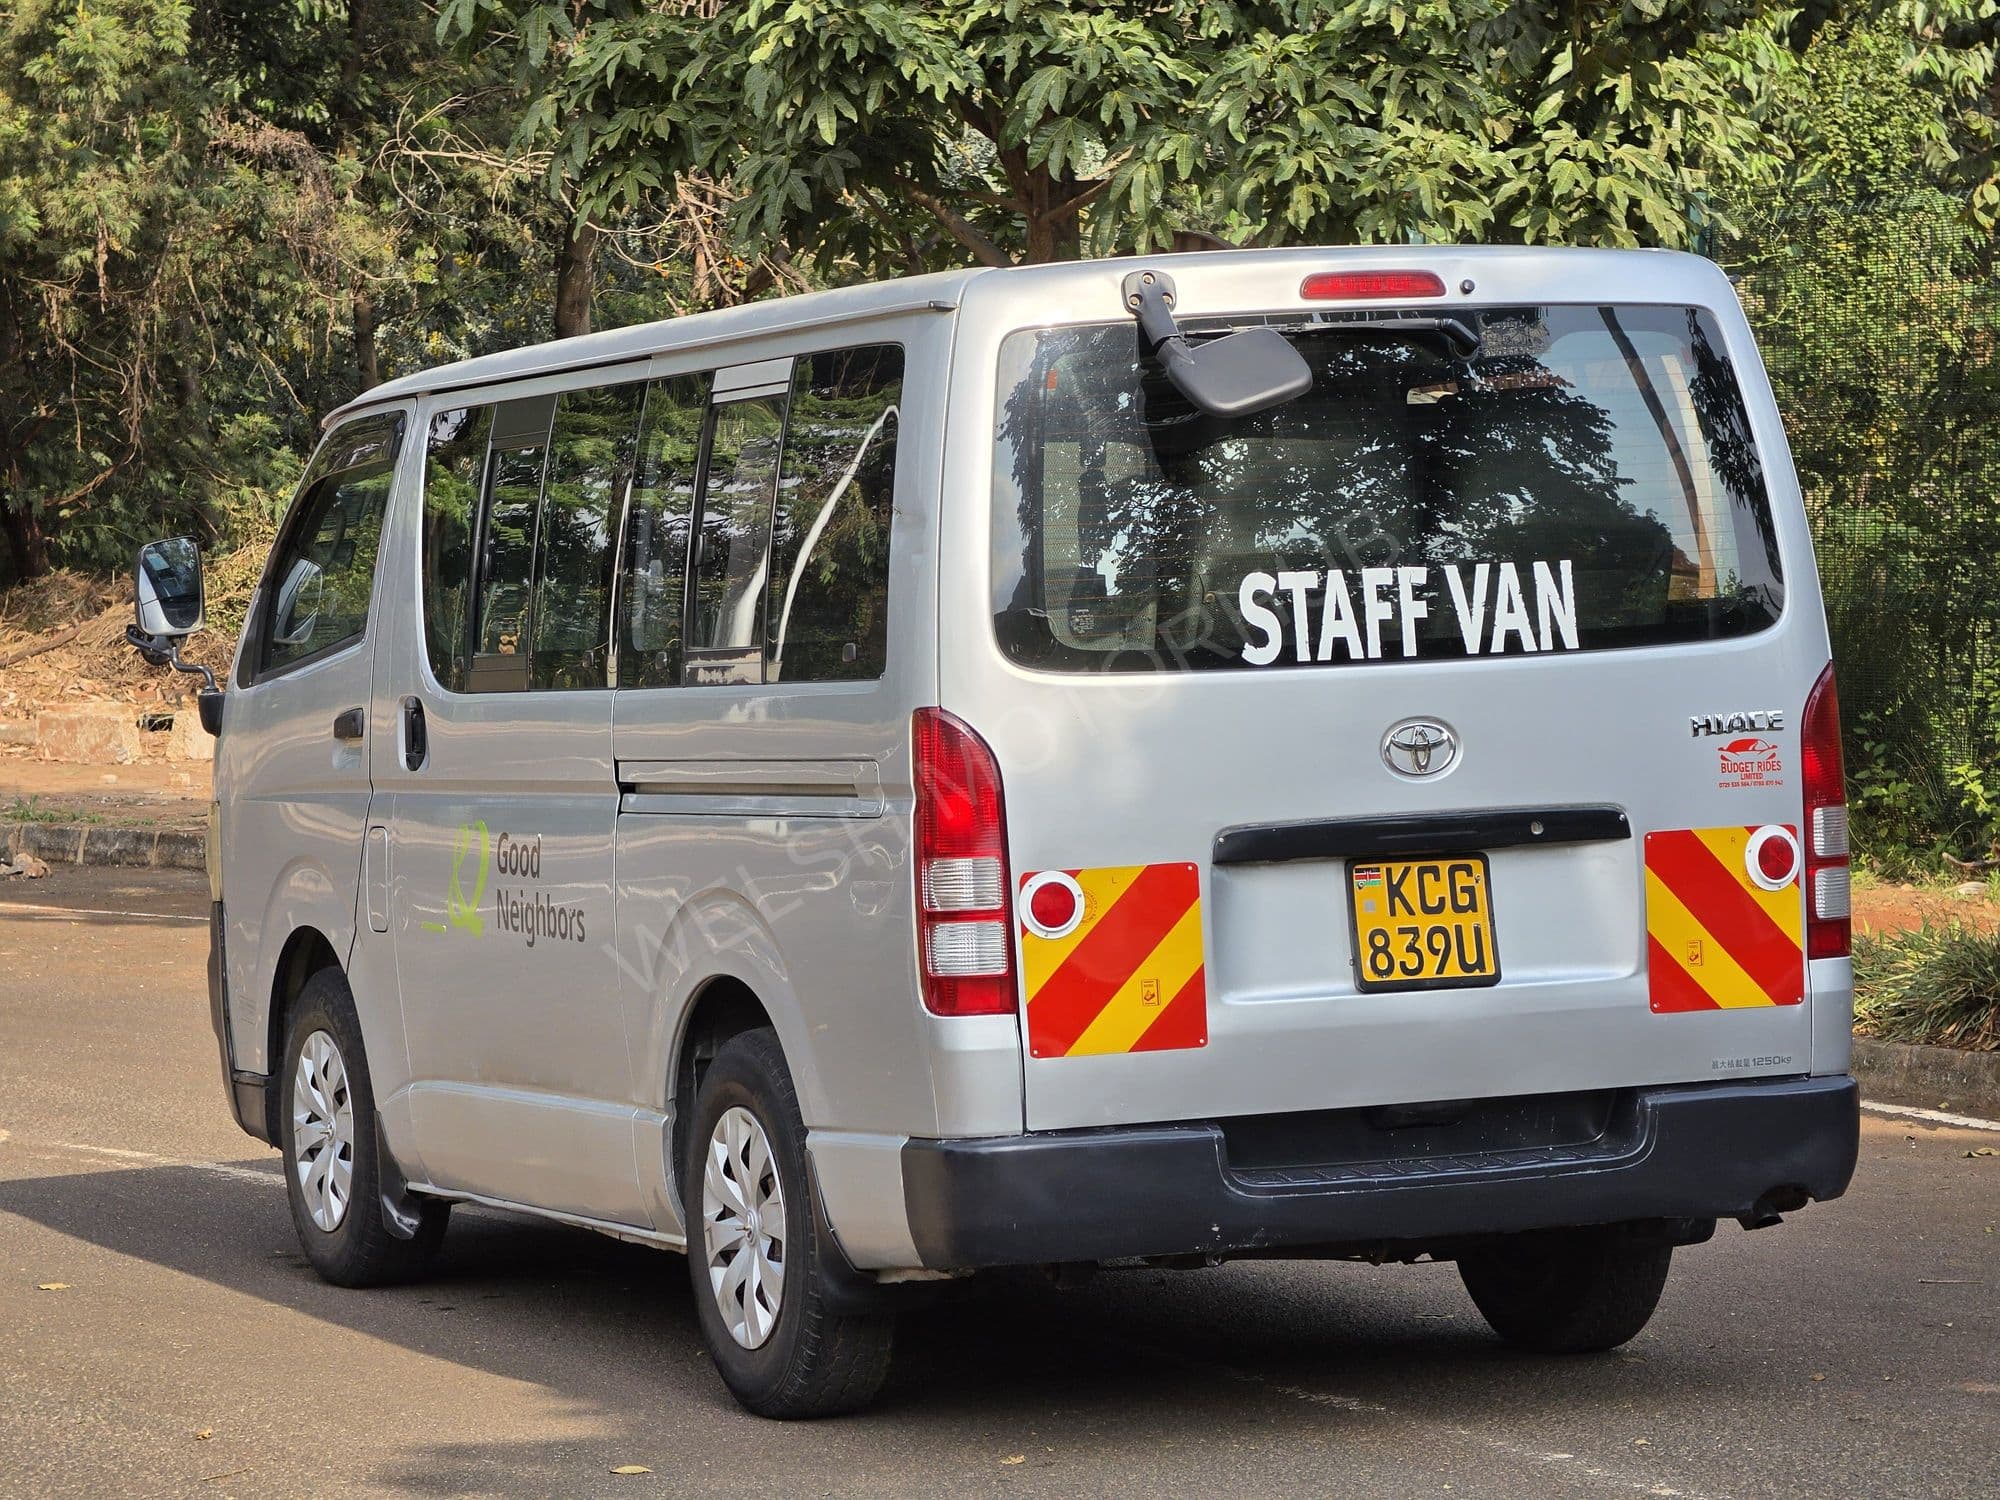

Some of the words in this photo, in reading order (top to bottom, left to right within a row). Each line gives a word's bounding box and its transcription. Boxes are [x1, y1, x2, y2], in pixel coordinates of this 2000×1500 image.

[1239, 567, 1427, 665] STAFF
[1444, 560, 1580, 654] VAN
[1689, 709, 1785, 737] HIACE
[1720, 762, 1754, 773] BUDGET
[1757, 760, 1782, 772] RIDES
[497, 832, 541, 879] Good
[1386, 864, 1478, 917] KCG
[496, 889, 586, 948] Neighbors
[1368, 924, 1487, 979] 839U
[1752, 1055, 1792, 1067] 1250kg
